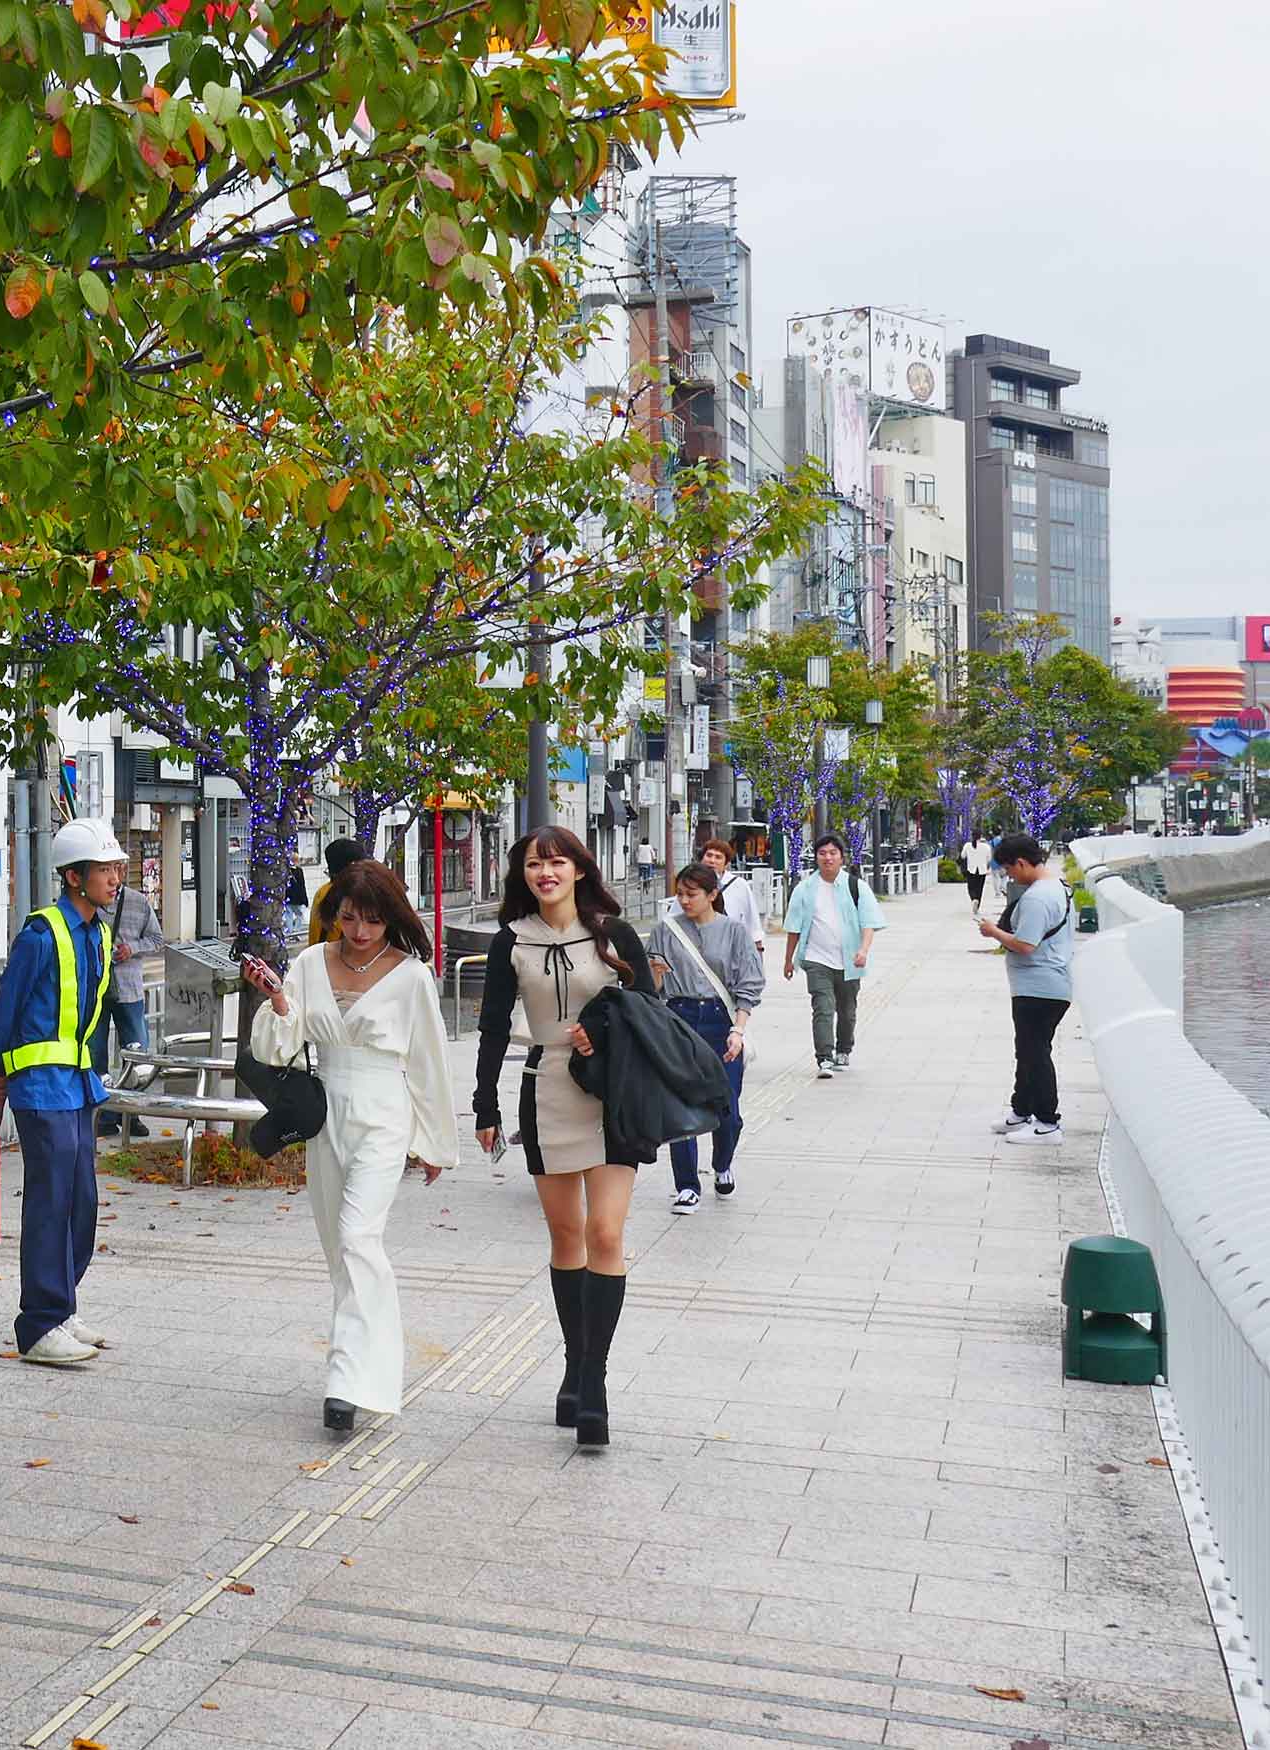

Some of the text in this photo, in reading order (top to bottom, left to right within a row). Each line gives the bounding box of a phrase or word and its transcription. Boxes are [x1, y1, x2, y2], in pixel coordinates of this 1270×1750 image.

[661, 3, 720, 30] Asahi
[683, 33, 698, 46] 生
[874, 329, 941, 362] かすうどん
